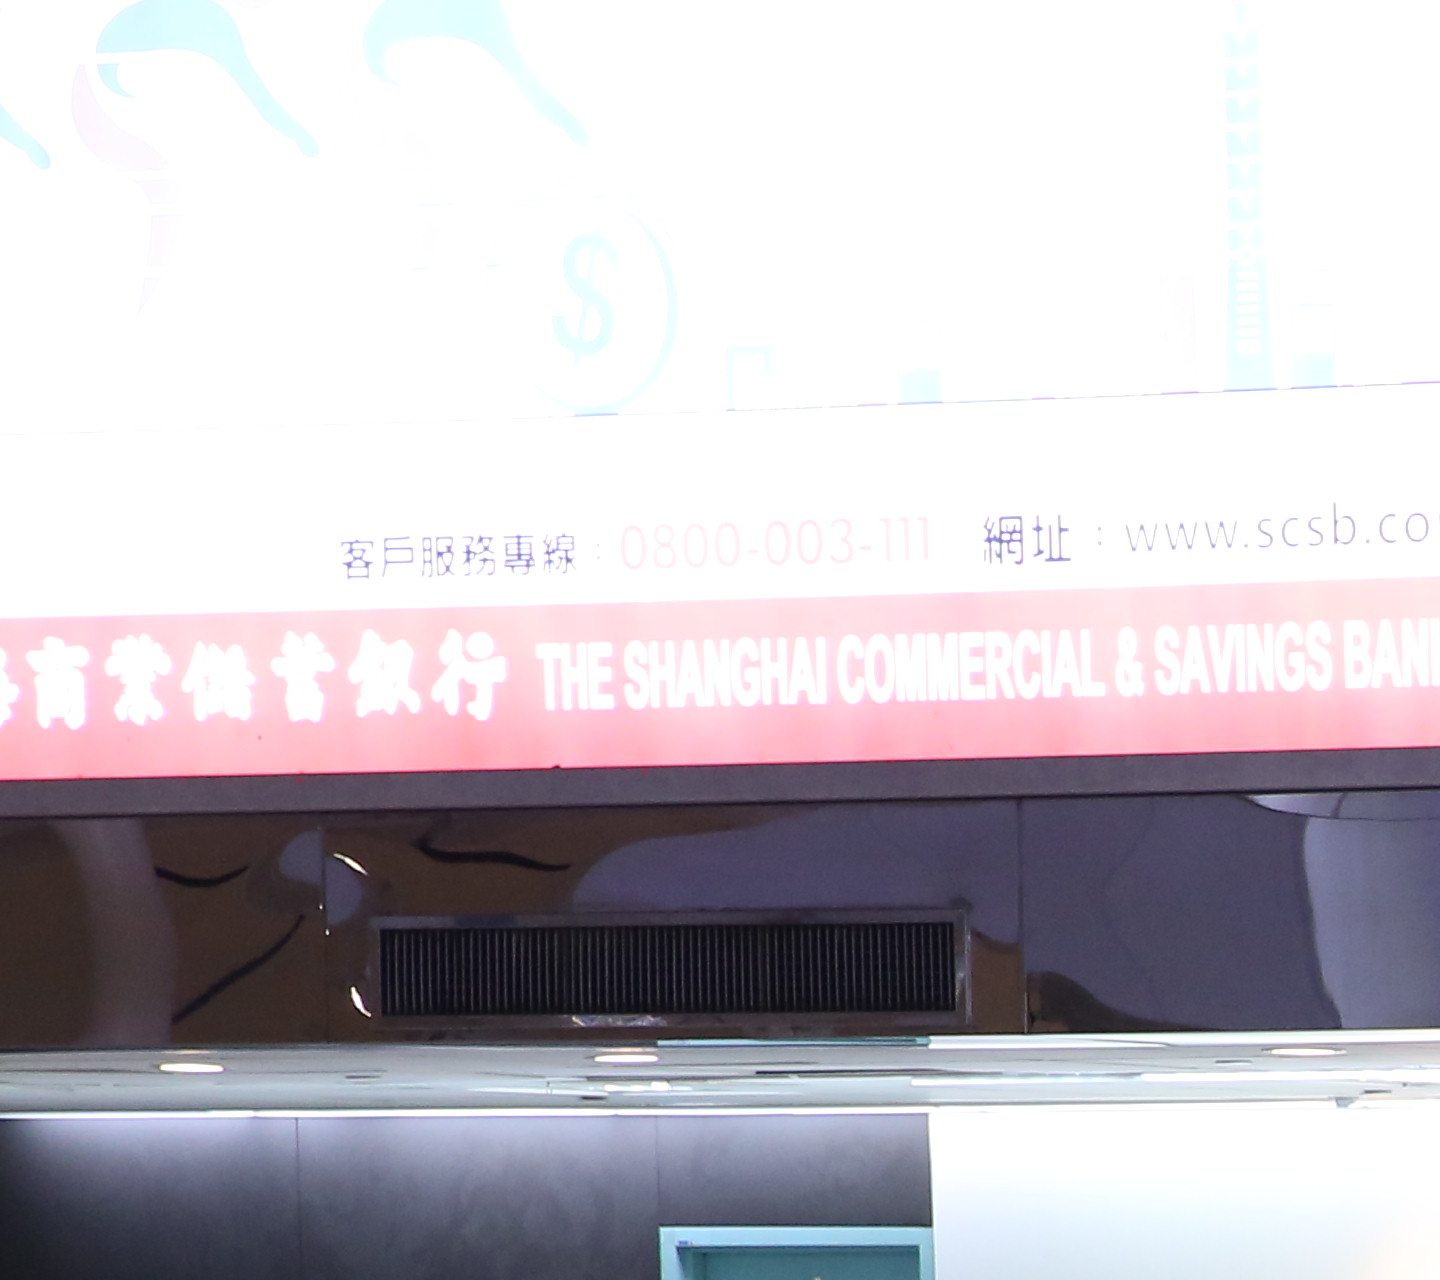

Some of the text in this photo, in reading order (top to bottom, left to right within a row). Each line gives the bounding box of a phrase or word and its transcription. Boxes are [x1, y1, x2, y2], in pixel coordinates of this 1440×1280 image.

[620, 515, 932, 571] 0800-003-111
[535, 641, 614, 711] THE
[624, 636, 827, 710] SHANGHAI
[837, 628, 1105, 704] COMMERCIAL
[1115, 626, 1144, 696] &
[1154, 621, 1332, 695] SAVINGS
